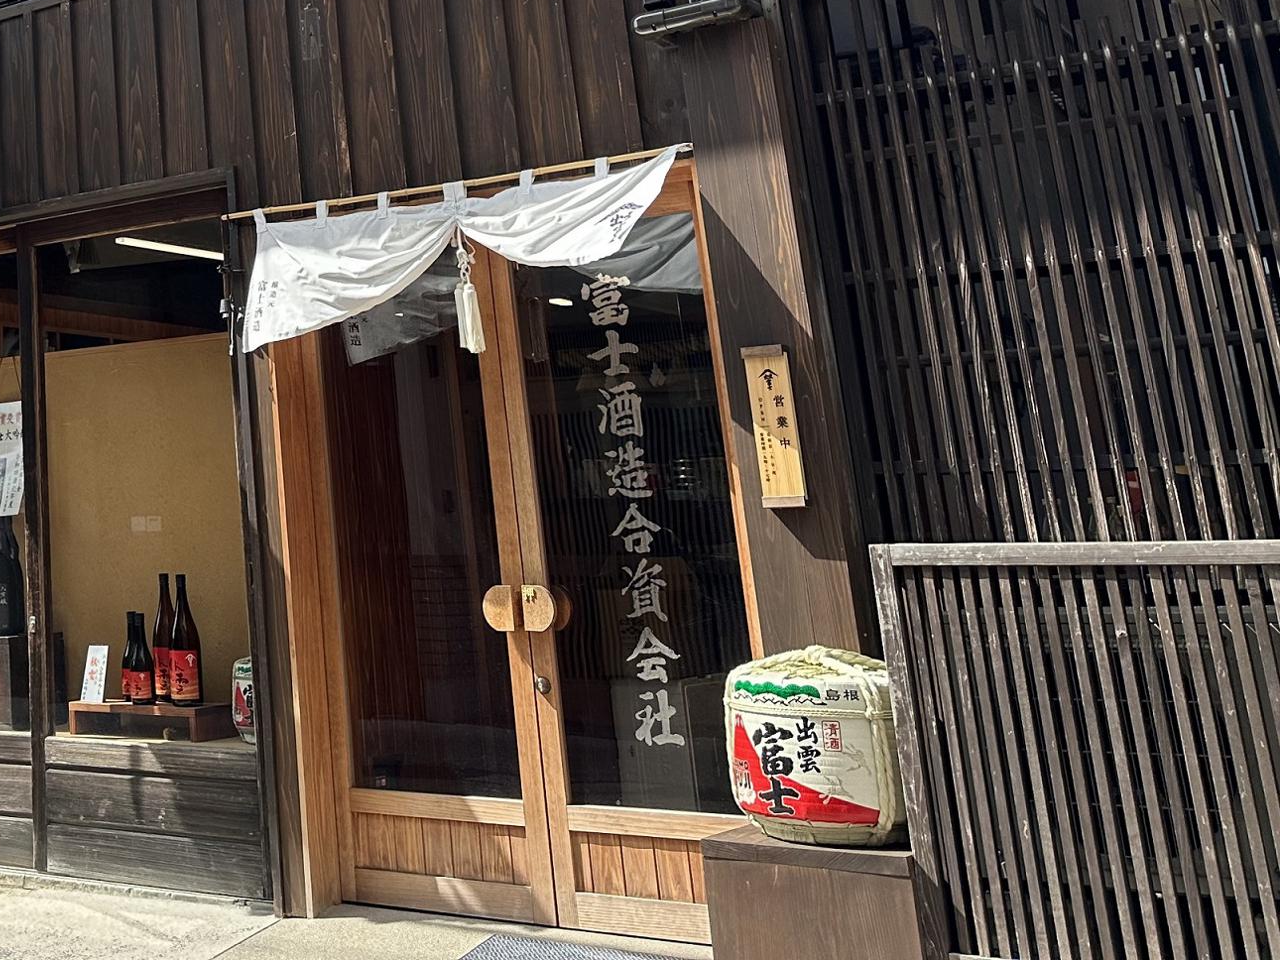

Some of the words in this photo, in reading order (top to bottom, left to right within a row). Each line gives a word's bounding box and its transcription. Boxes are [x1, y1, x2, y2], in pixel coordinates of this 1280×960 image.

[773, 395, 791, 450] 営業中
[581, 272, 685, 747] 富士酒造合資会社
[825, 688, 860, 702] 島根
[796, 716, 821, 774] 出雲
[824, 722, 840, 751] 清酒
[752, 721, 801, 815] 富士
